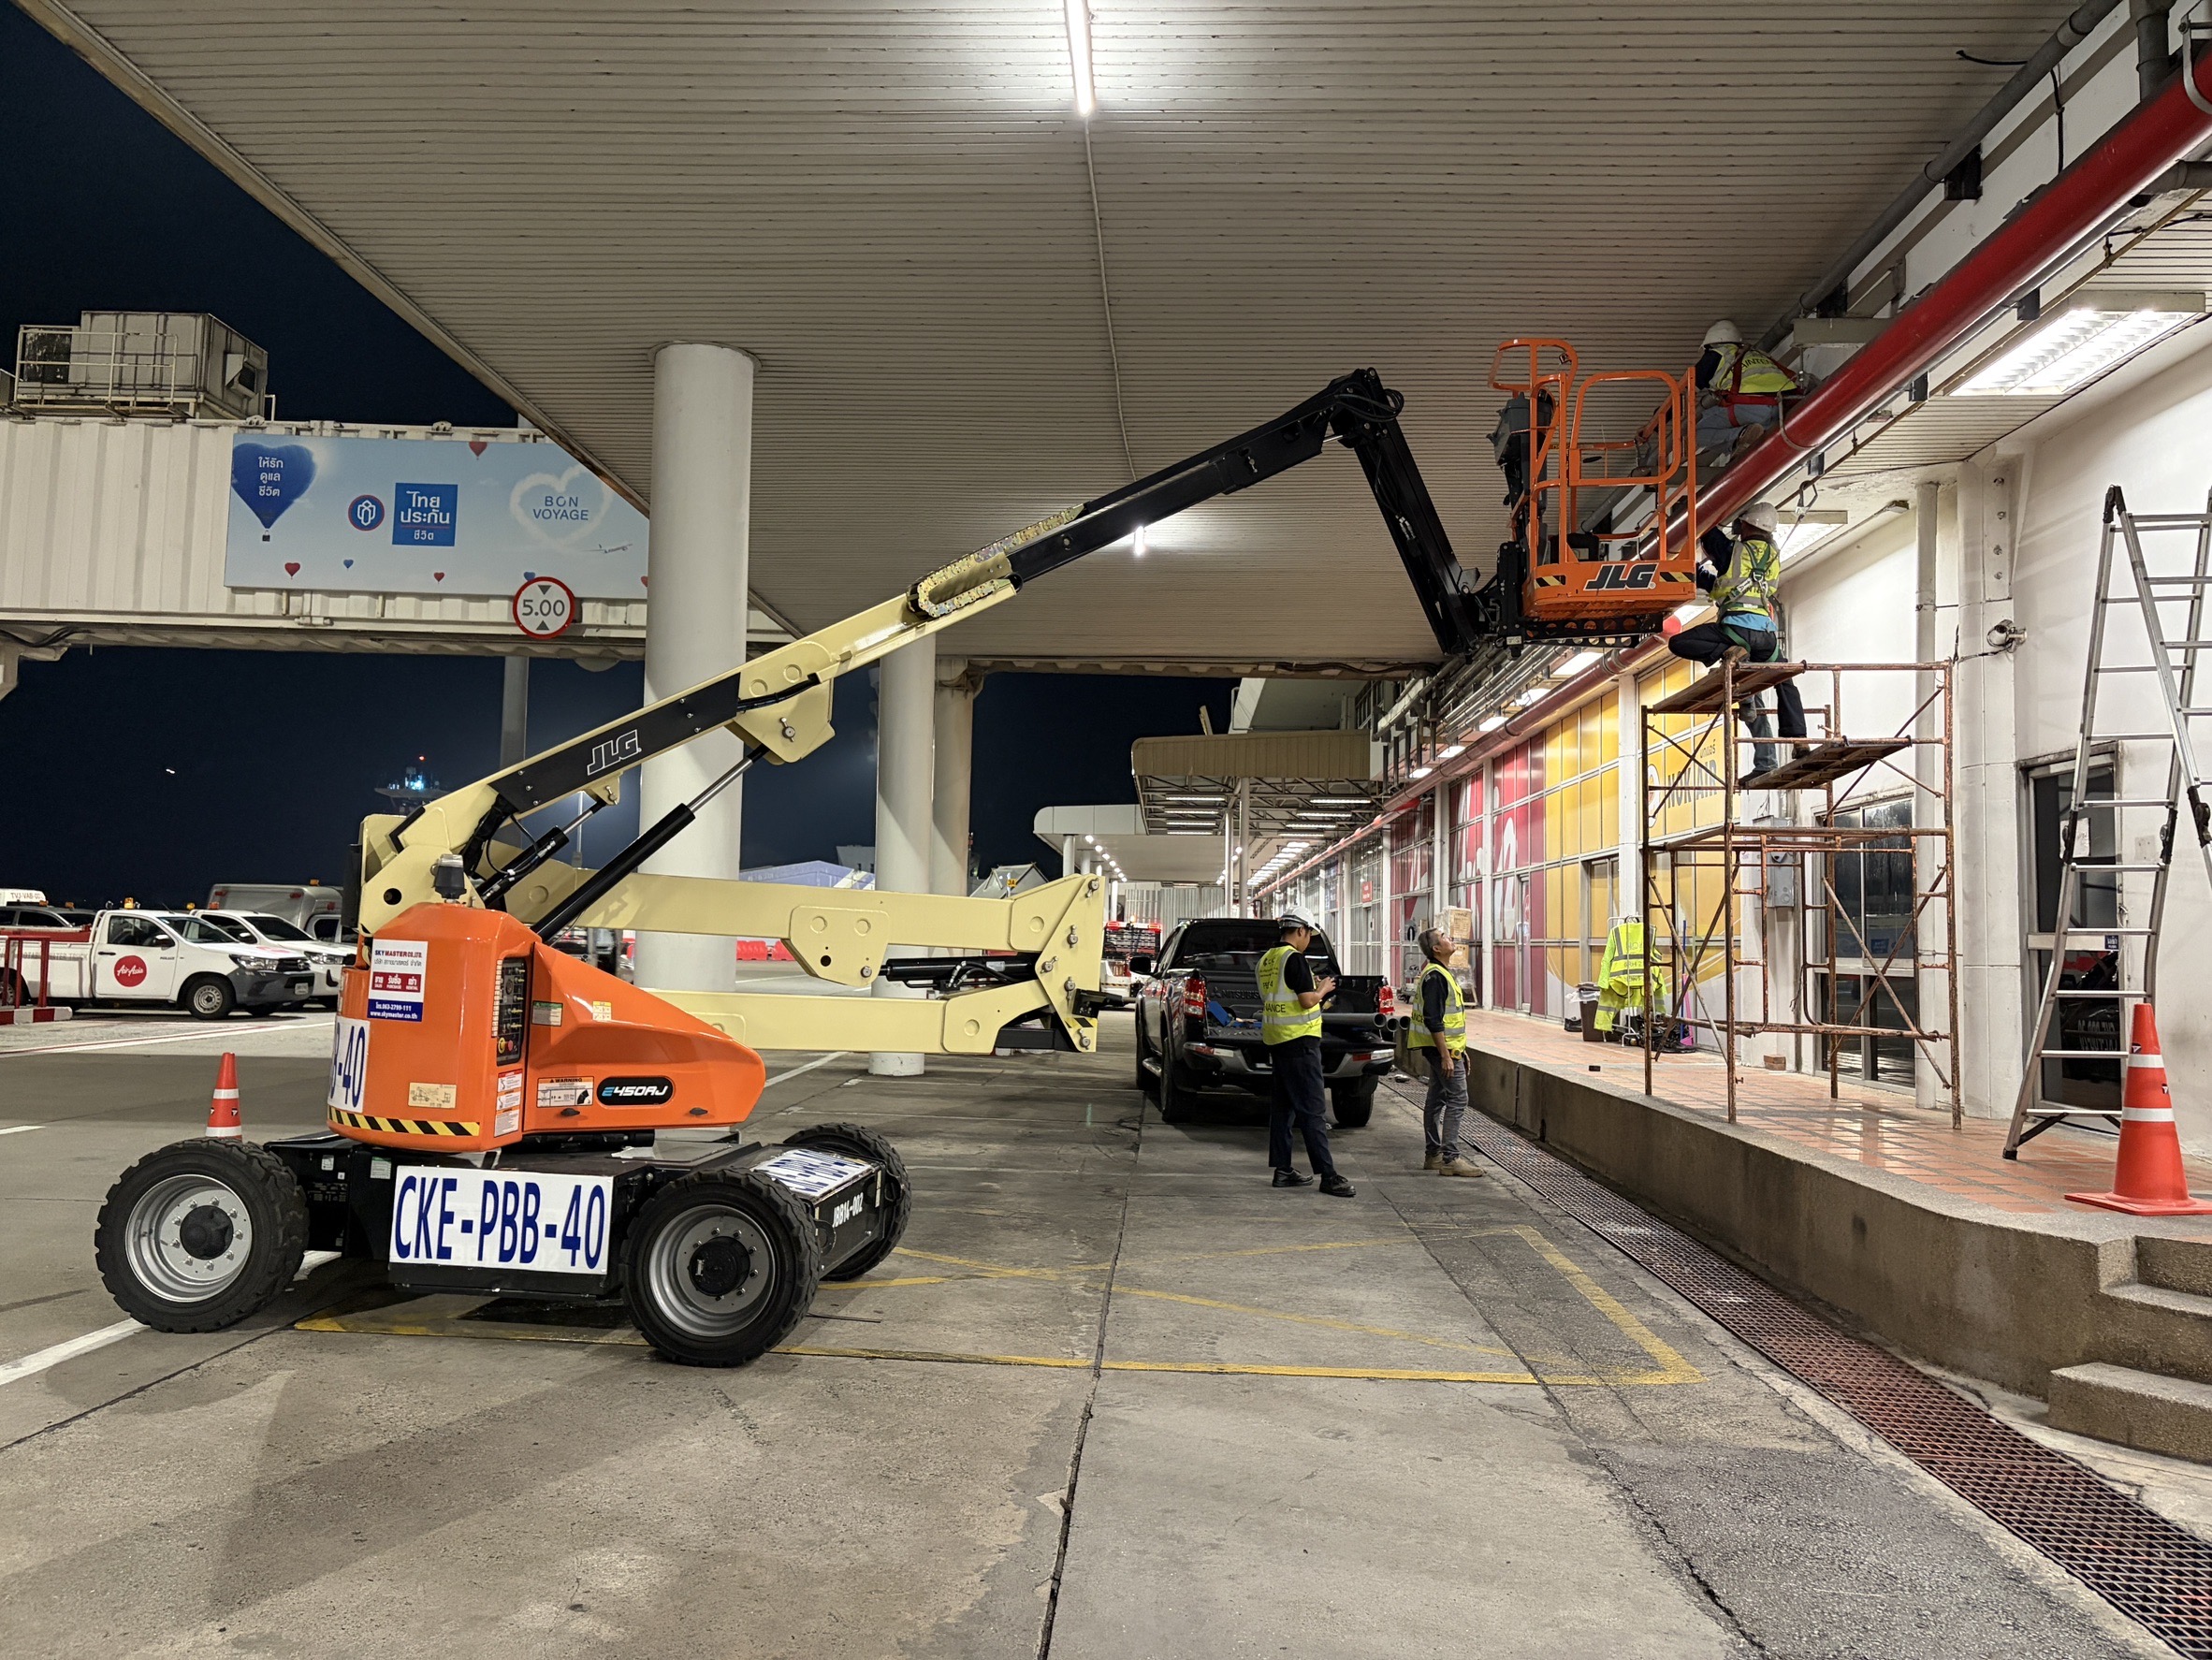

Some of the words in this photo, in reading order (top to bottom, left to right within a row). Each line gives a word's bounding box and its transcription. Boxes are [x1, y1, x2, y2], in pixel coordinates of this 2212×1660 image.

[258, 456, 284, 468] ให้รัก
[260, 472, 281, 484] ดูแล
[258, 486, 281, 497] ชีวิต
[406, 490, 441, 508] ไทย
[545, 495, 578, 507] BON
[400, 508, 450, 524] ประกัน
[532, 508, 589, 521] VOYAGE
[414, 530, 434, 540] ชีวิต
[1583, 562, 1659, 590] JLG
[522, 600, 565, 617] 5.00
[587, 729, 642, 776] JLG
[1695, 759, 1718, 801] AIR
[601, 1085, 669, 1097] E450AJ
[394, 1175, 605, 1270] CKE-PBB-40
